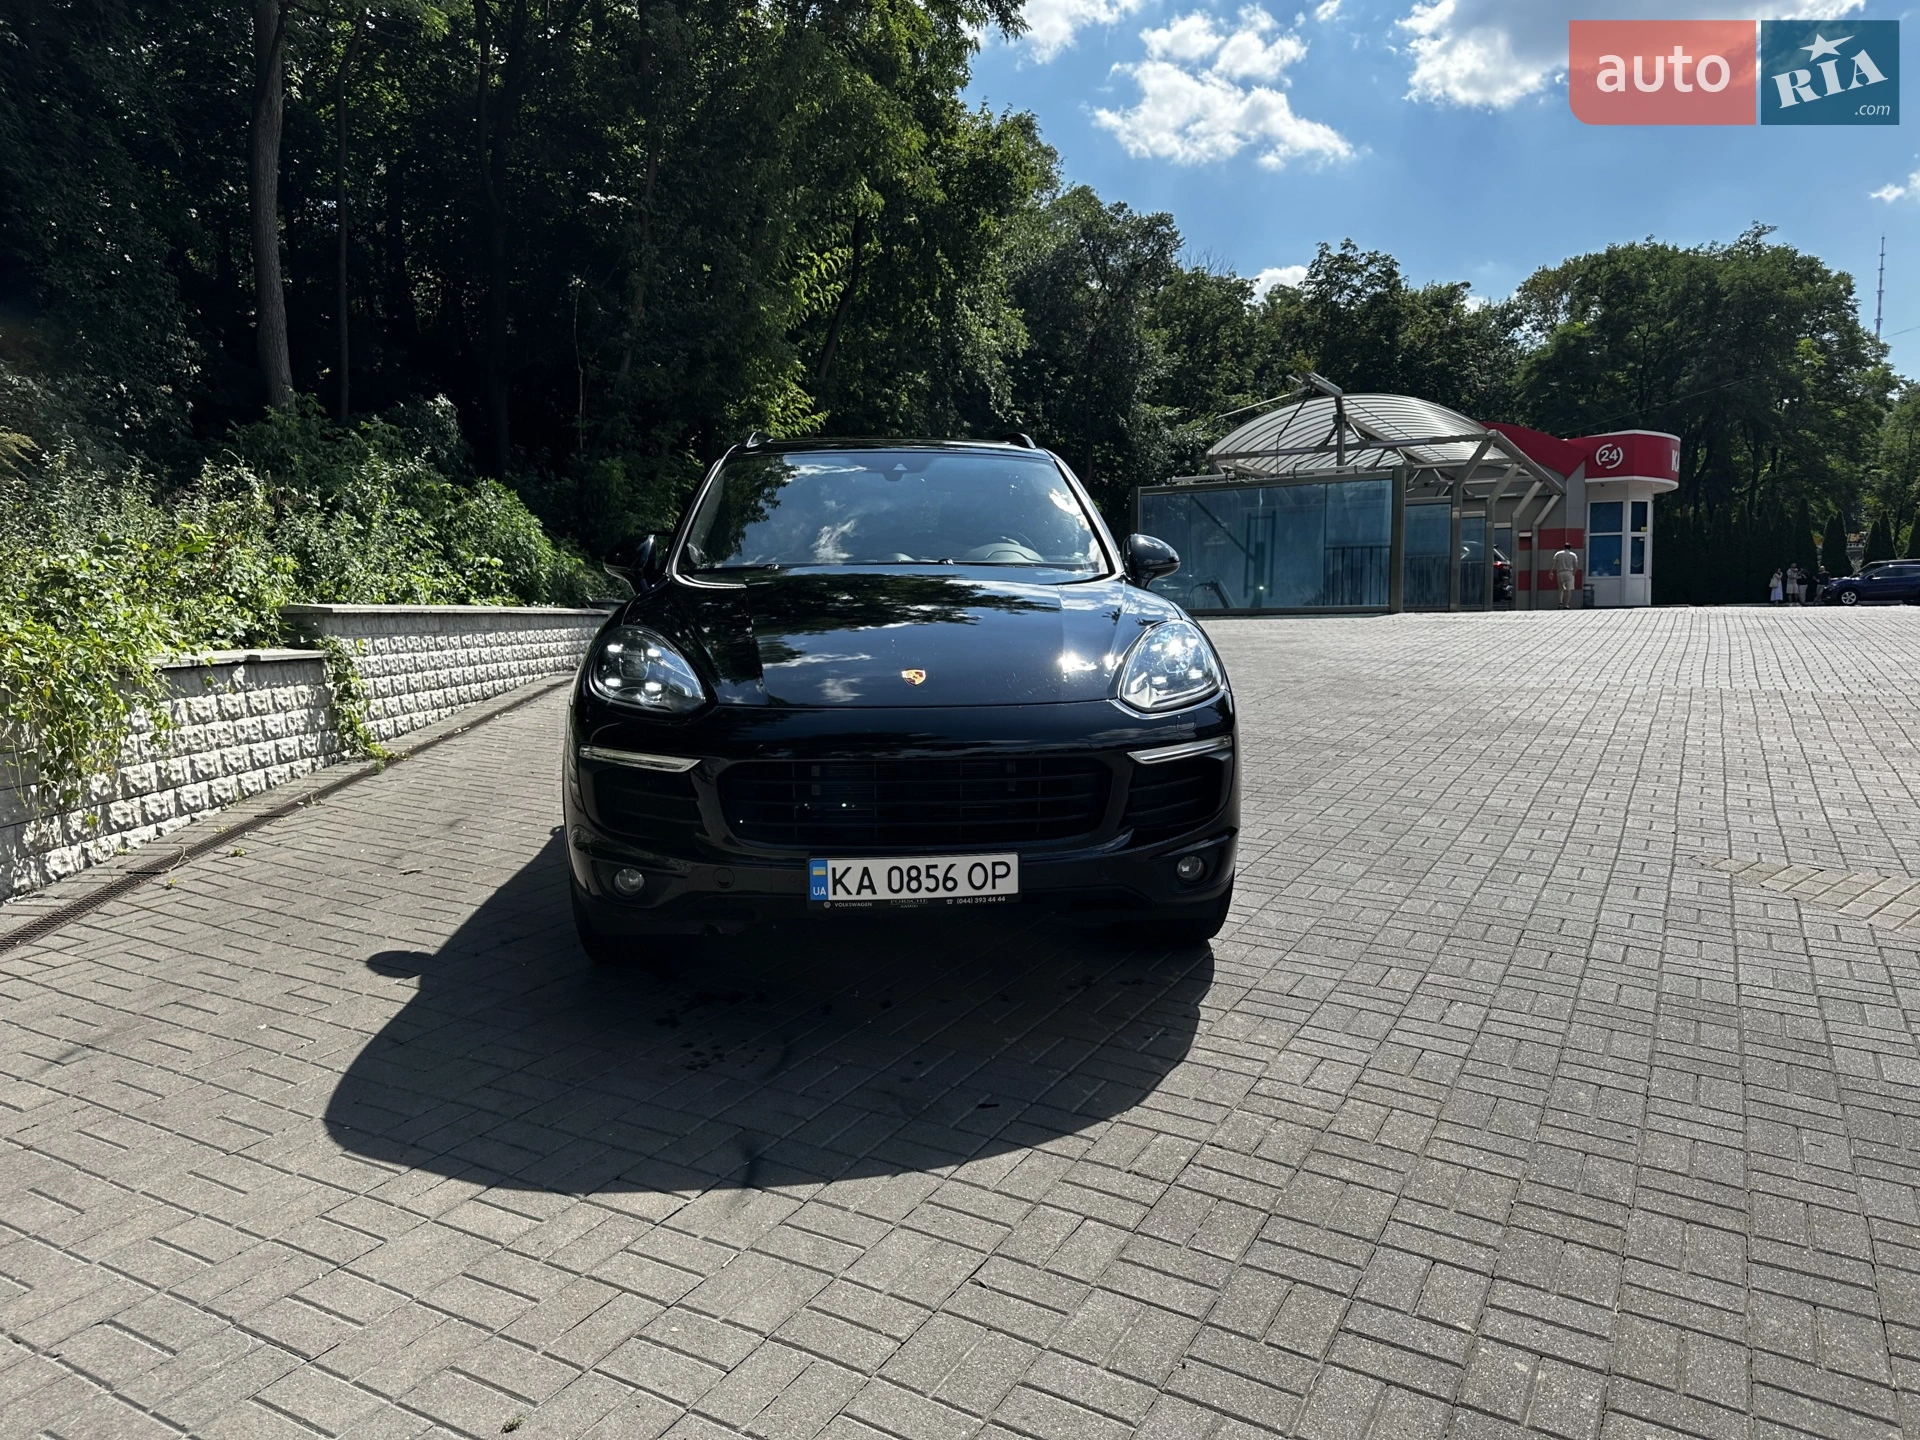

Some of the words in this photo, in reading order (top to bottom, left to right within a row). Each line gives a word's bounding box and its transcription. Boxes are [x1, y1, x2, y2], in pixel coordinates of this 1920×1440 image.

[1600, 449, 1618, 462] 24
[831, 866, 877, 896] KA
[887, 863, 958, 894] 0856
[967, 860, 1011, 890] OP
[812, 887, 827, 896] UA
[956, 897, 973, 905] (044)
[974, 896, 987, 904] 393
